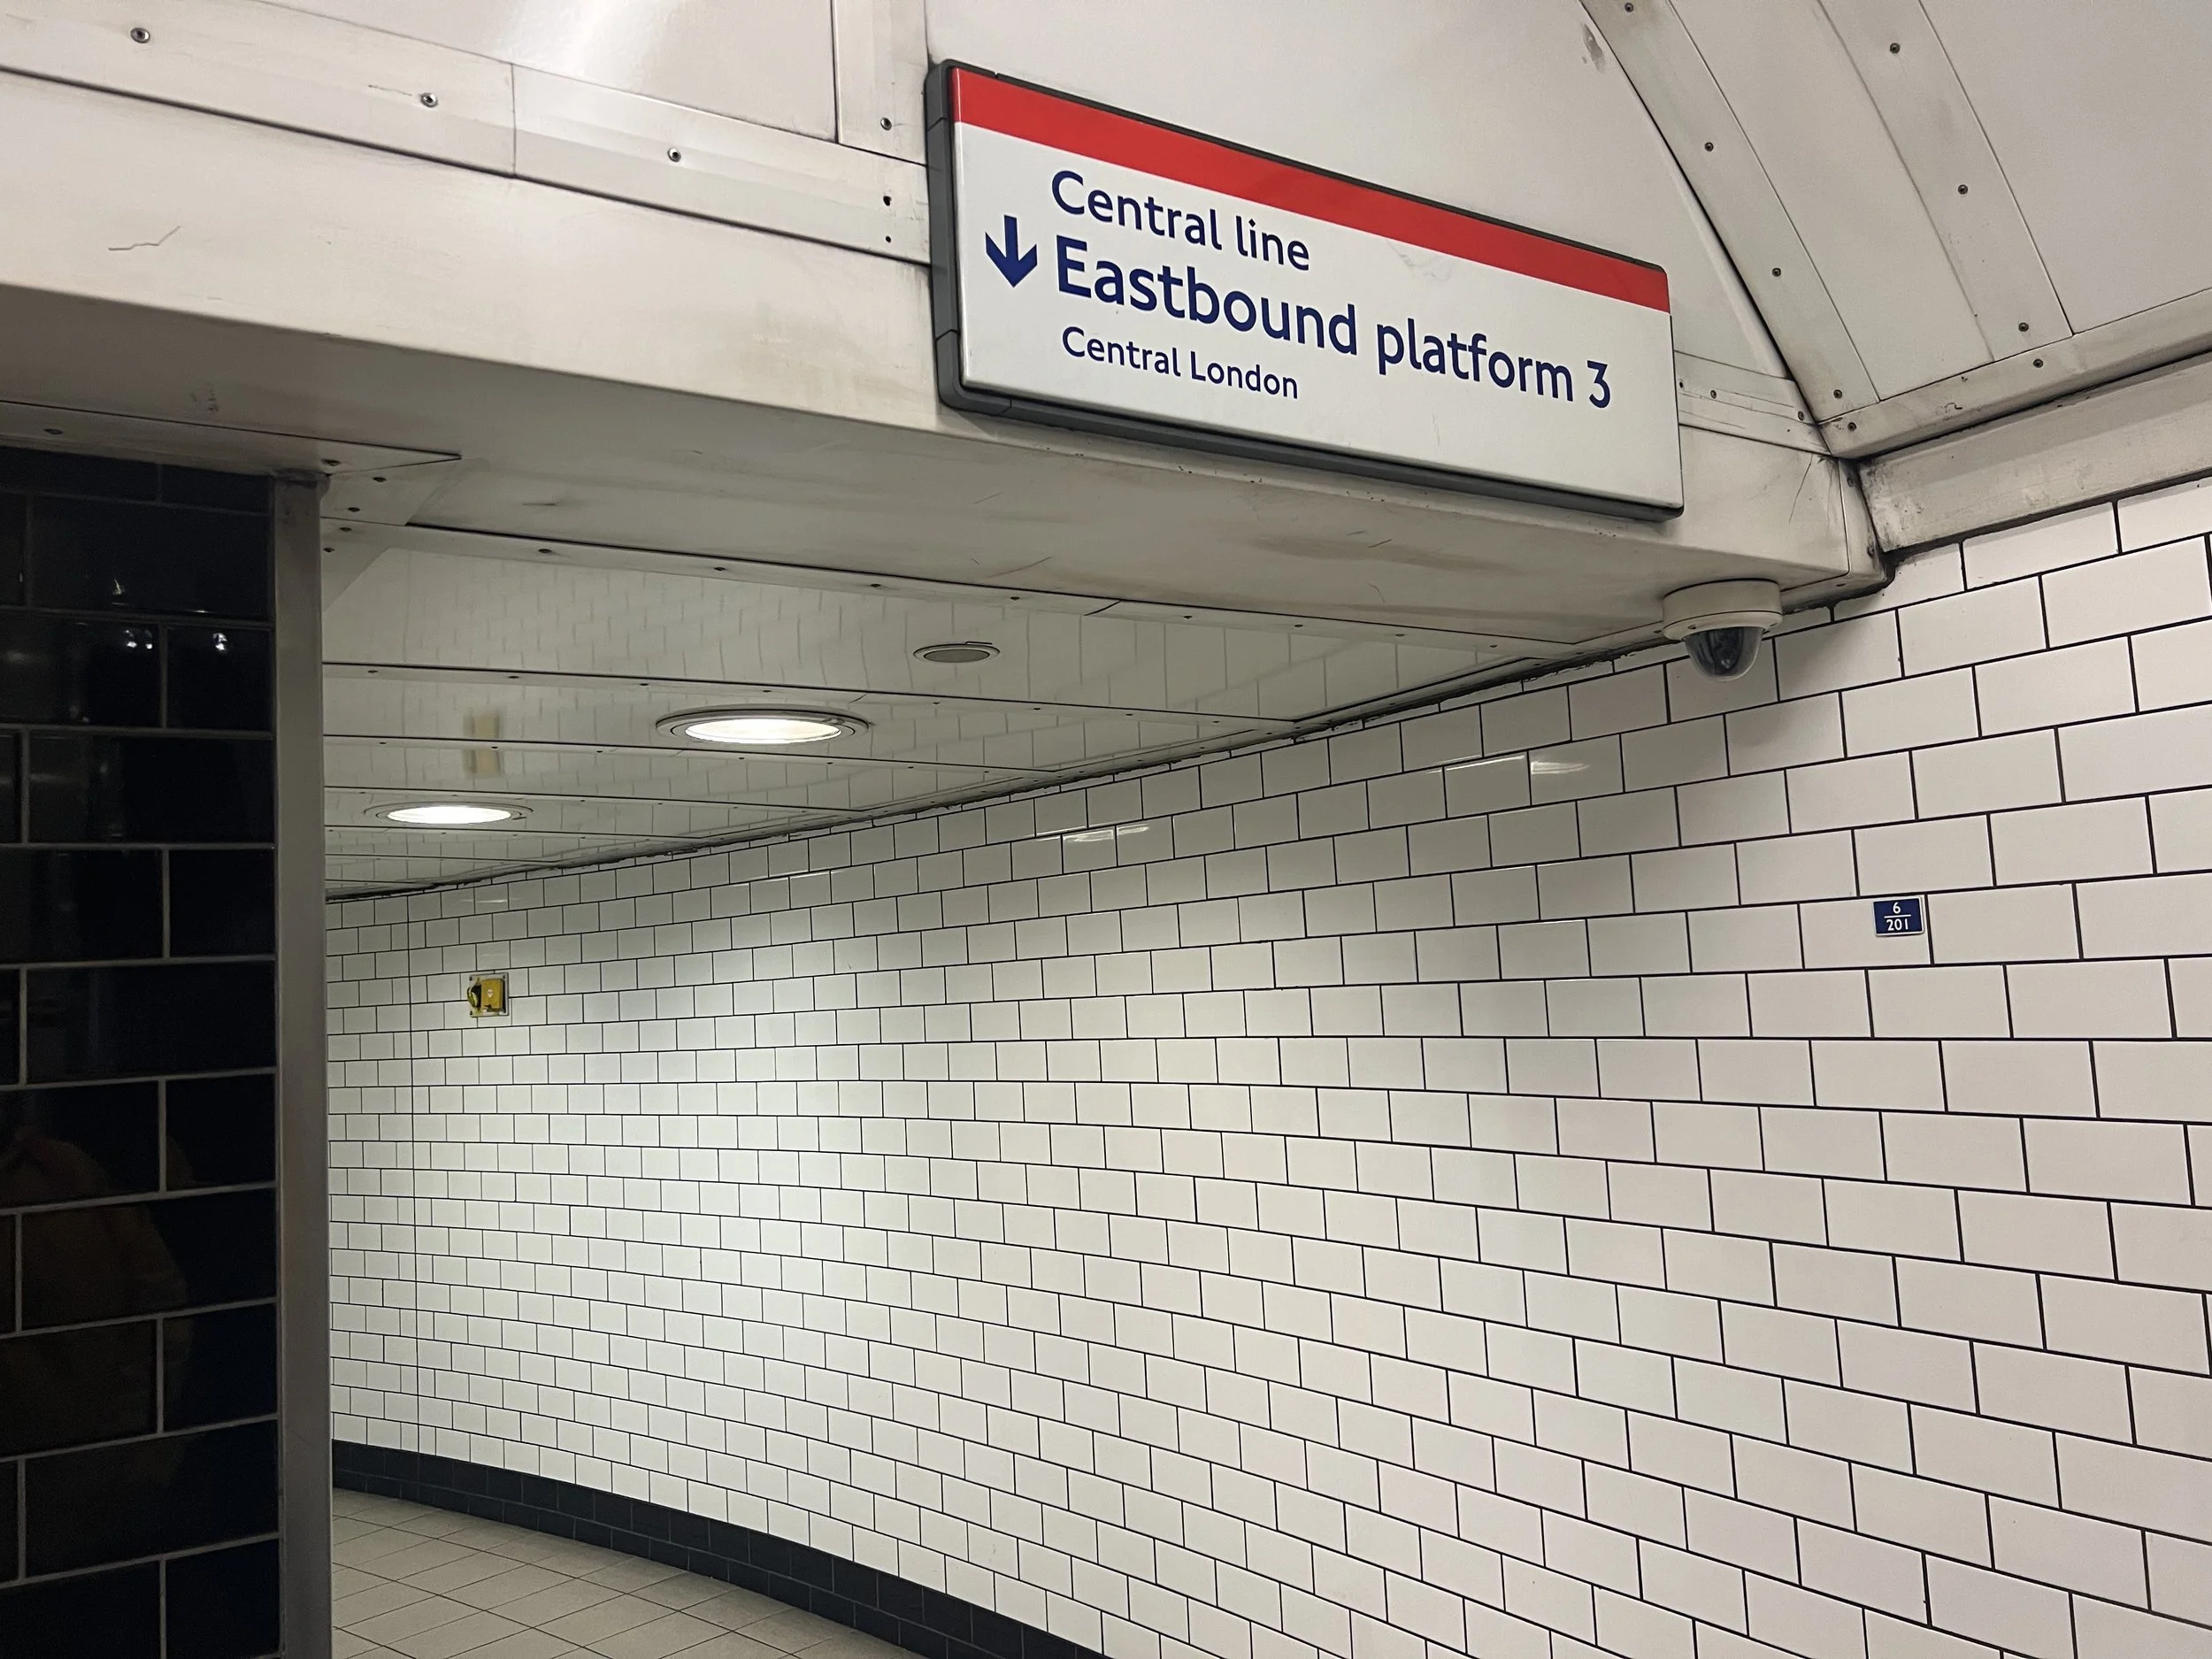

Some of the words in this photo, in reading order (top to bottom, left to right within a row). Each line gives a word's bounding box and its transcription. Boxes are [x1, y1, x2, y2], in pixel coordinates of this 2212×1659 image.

[1051, 170, 1223, 250] Central
[1235, 215, 1310, 271] line
[1056, 234, 1357, 356] Eastbound
[1376, 319, 1574, 403] platform
[1587, 359, 1611, 409] 3
[1062, 326, 1181, 377] Central
[1190, 350, 1298, 399] London
[1886, 918, 1909, 931] 201
[1893, 902, 1901, 914] 6
